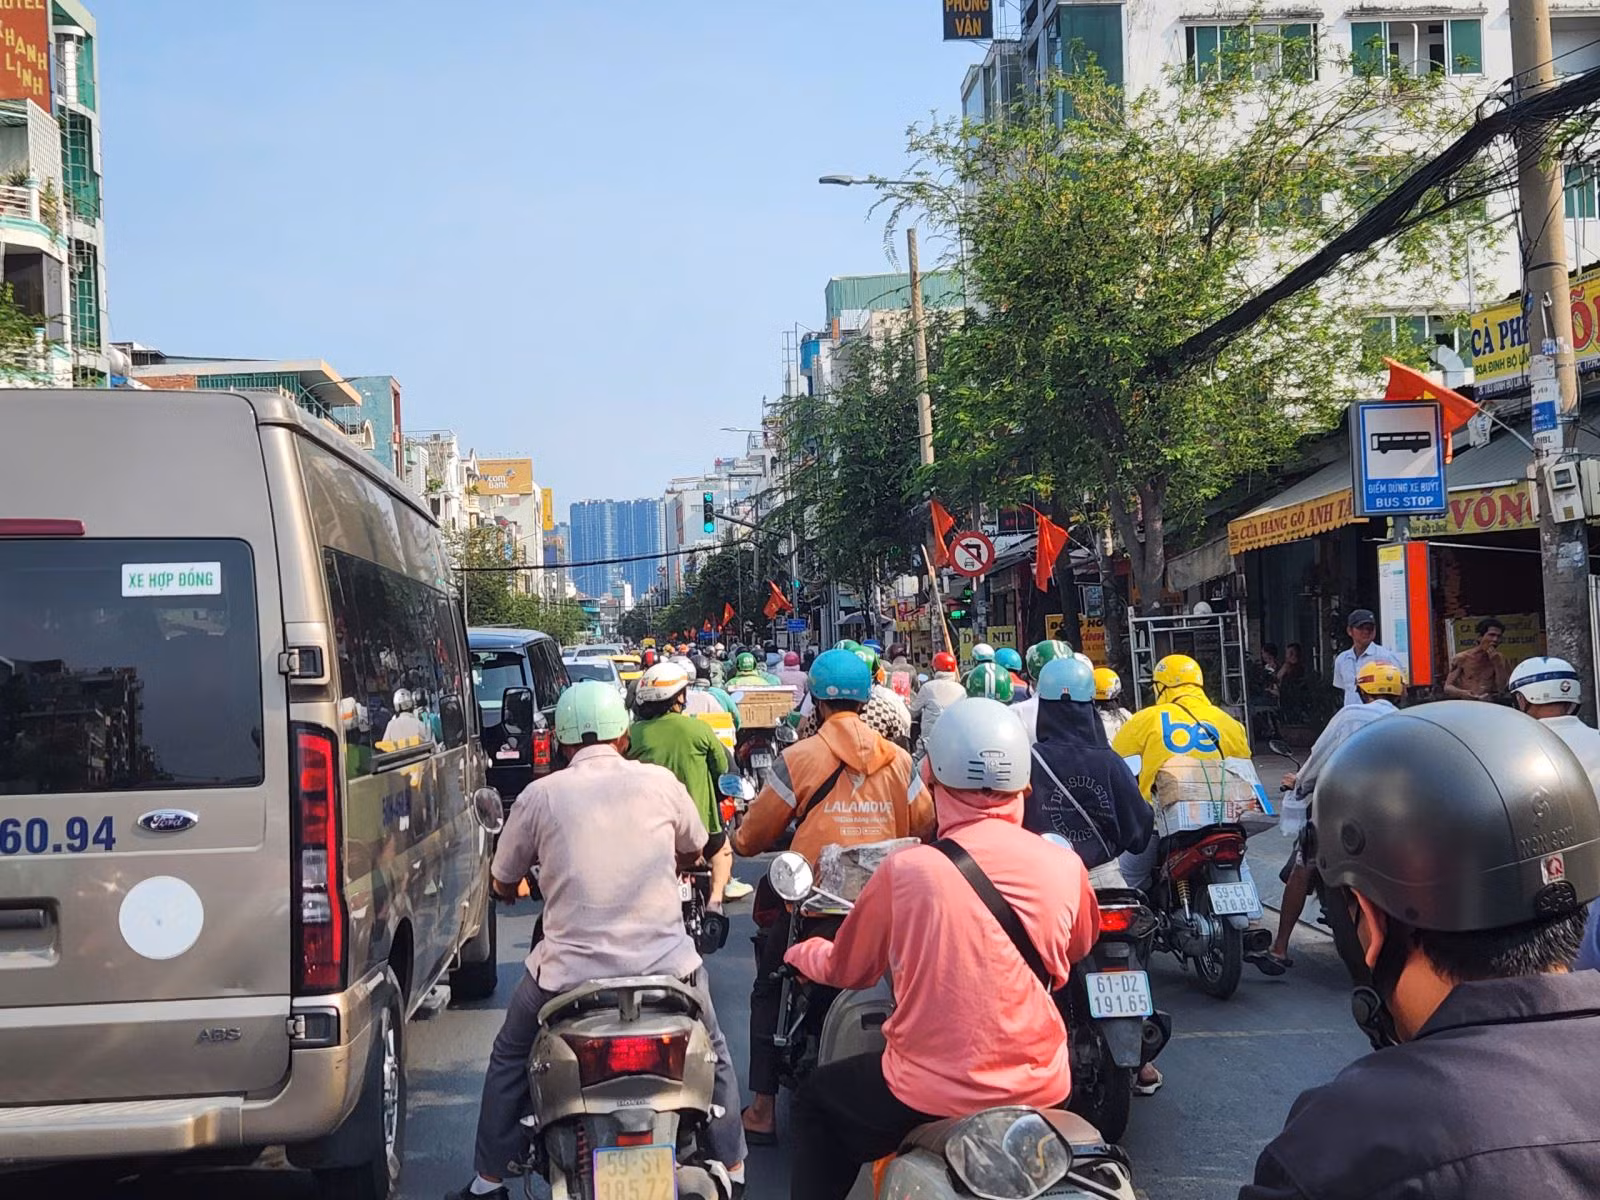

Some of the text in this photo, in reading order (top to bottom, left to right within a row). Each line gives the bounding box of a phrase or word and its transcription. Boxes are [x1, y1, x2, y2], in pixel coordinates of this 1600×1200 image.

[0, 0, 45, 9] OTEL
[955, 13, 982, 36] VÂN
[6, 52, 43, 95] LINH
[1410, 482, 1420, 492] XE
[1420, 479, 1439, 492] BUÝT
[1376, 495, 1434, 508] BUS STOP
[1307, 502, 1335, 528] ANH
[128, 573, 144, 588] XE
[149, 571, 174, 591] HỢP
[1161, 711, 1220, 754] be
[150, 813, 184, 829] Ford
[1215, 885, 1246, 899] 59-C1
[1096, 975, 1139, 993] 61-D2
[1095, 994, 1148, 1014] 191.65
[197, 1027, 242, 1041] ABS
